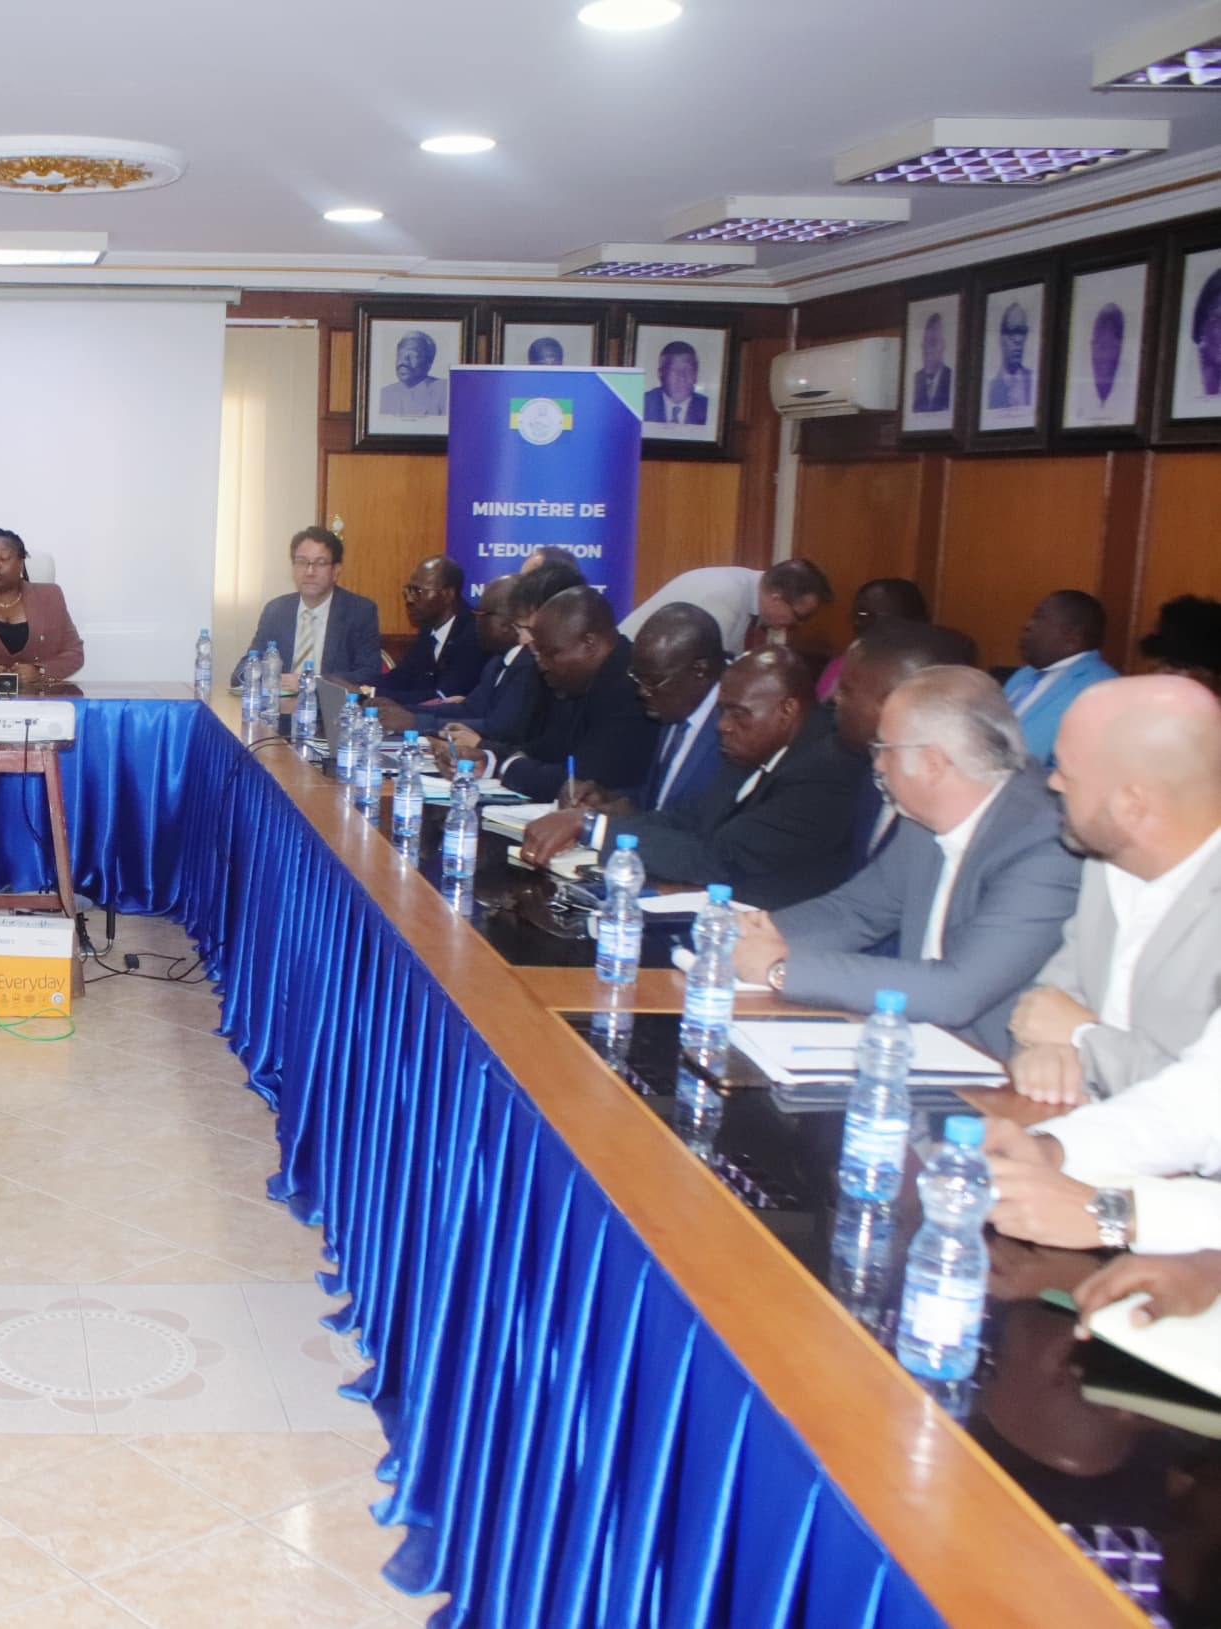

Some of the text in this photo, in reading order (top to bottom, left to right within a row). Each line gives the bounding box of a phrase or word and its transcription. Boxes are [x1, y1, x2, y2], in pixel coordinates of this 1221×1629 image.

[473, 499, 606, 517] MINISTÈRE DE
[478, 543, 602, 558] L'EDUON
